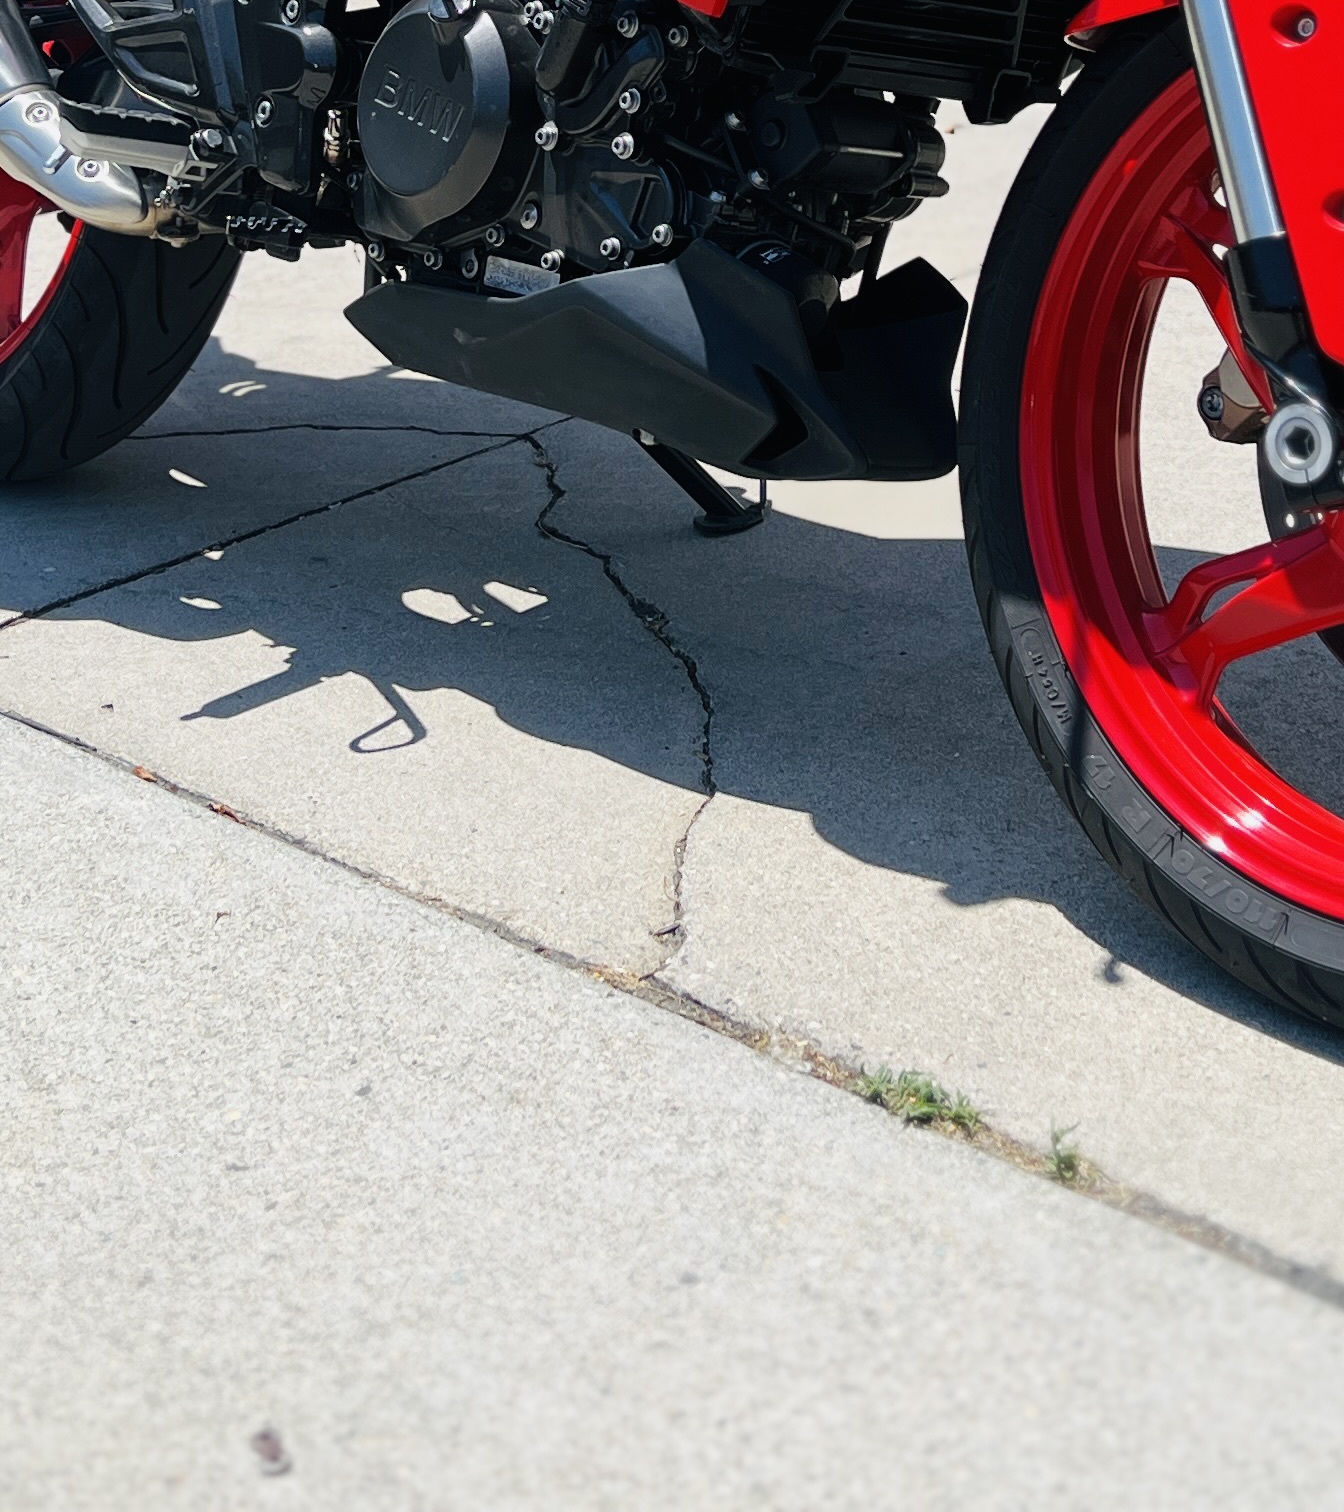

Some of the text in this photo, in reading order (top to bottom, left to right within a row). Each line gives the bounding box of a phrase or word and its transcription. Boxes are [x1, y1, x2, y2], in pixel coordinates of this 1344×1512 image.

[374, 63, 465, 144] BMW
[1083, 753, 1117, 792] 17
[1168, 849, 1281, 934] 110/70
